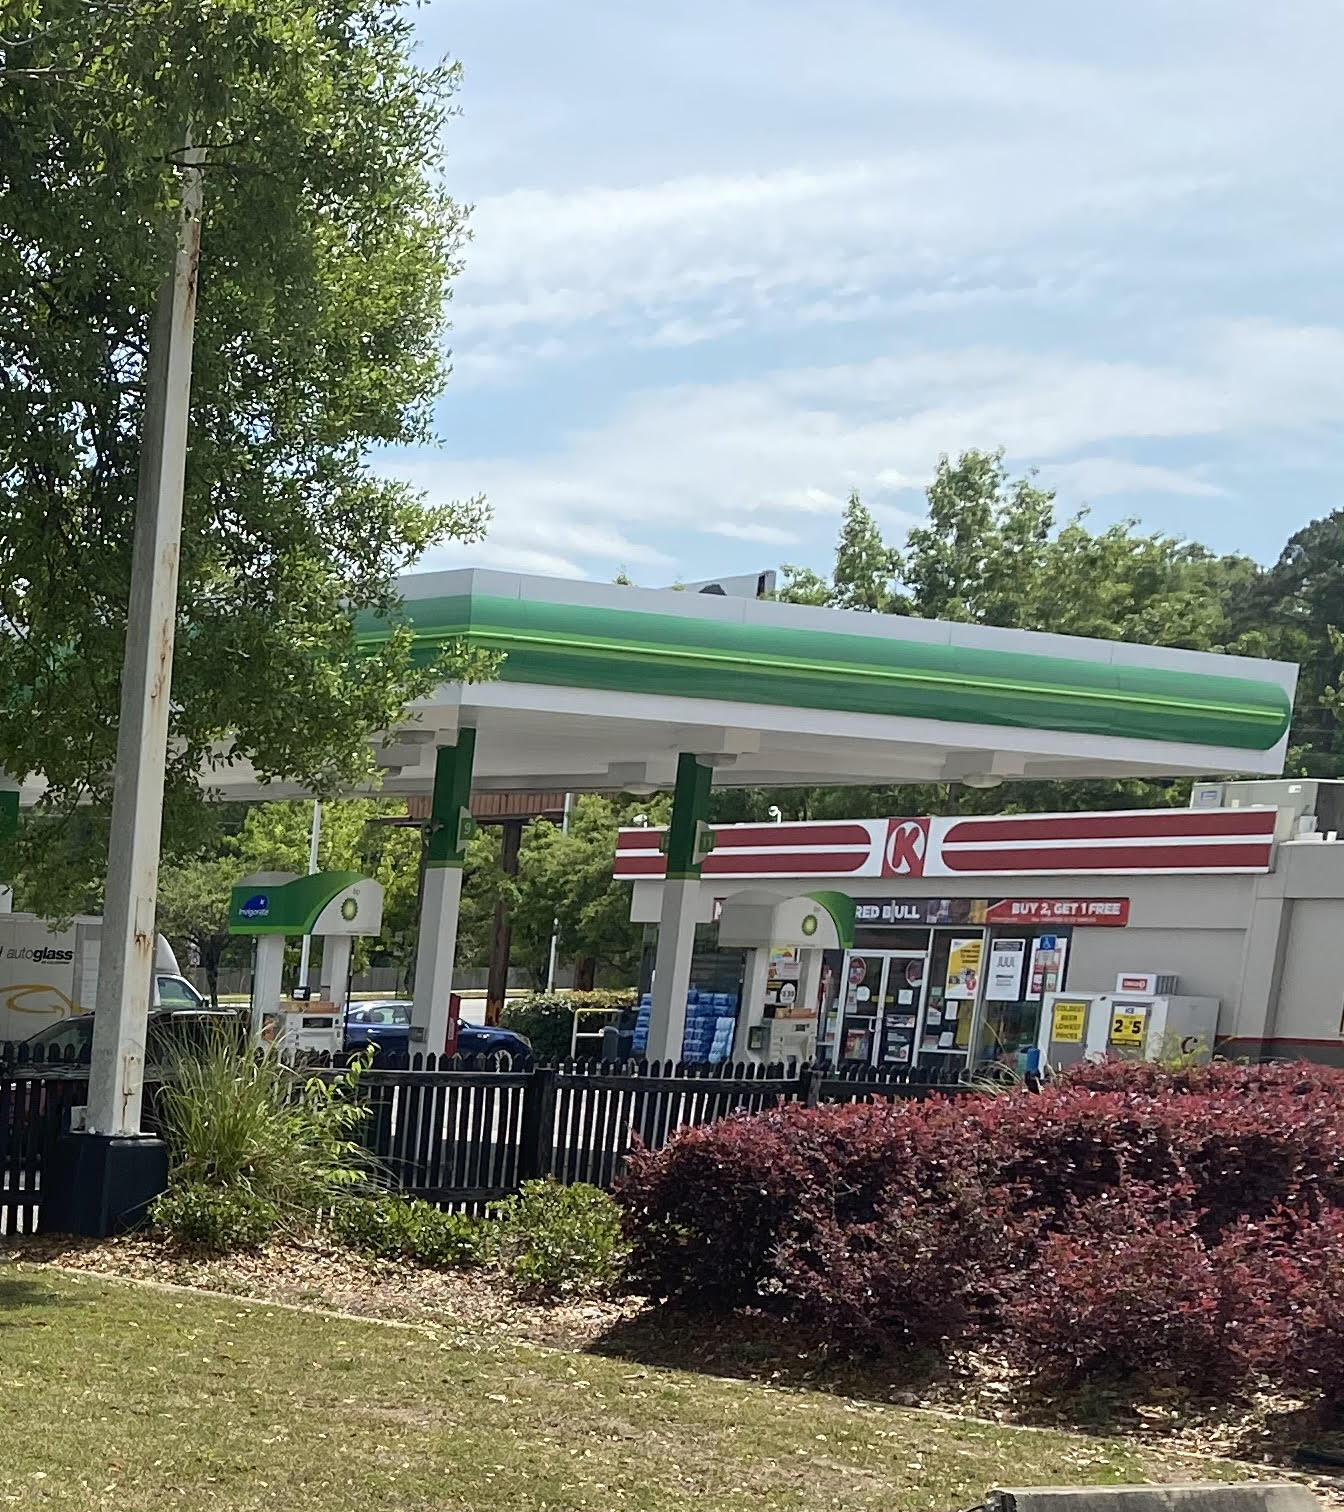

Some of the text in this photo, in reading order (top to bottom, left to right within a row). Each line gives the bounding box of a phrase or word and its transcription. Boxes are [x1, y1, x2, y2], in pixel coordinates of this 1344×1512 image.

[855, 905, 880, 919] RED
[1012, 903, 1038, 915] BUY
[1053, 903, 1079, 915] GET
[1080, 903, 1087, 915] 1
[1088, 903, 1121, 915] FREE
[6, 946, 74, 963] autoglass
[1113, 1019, 1123, 1032] 2
